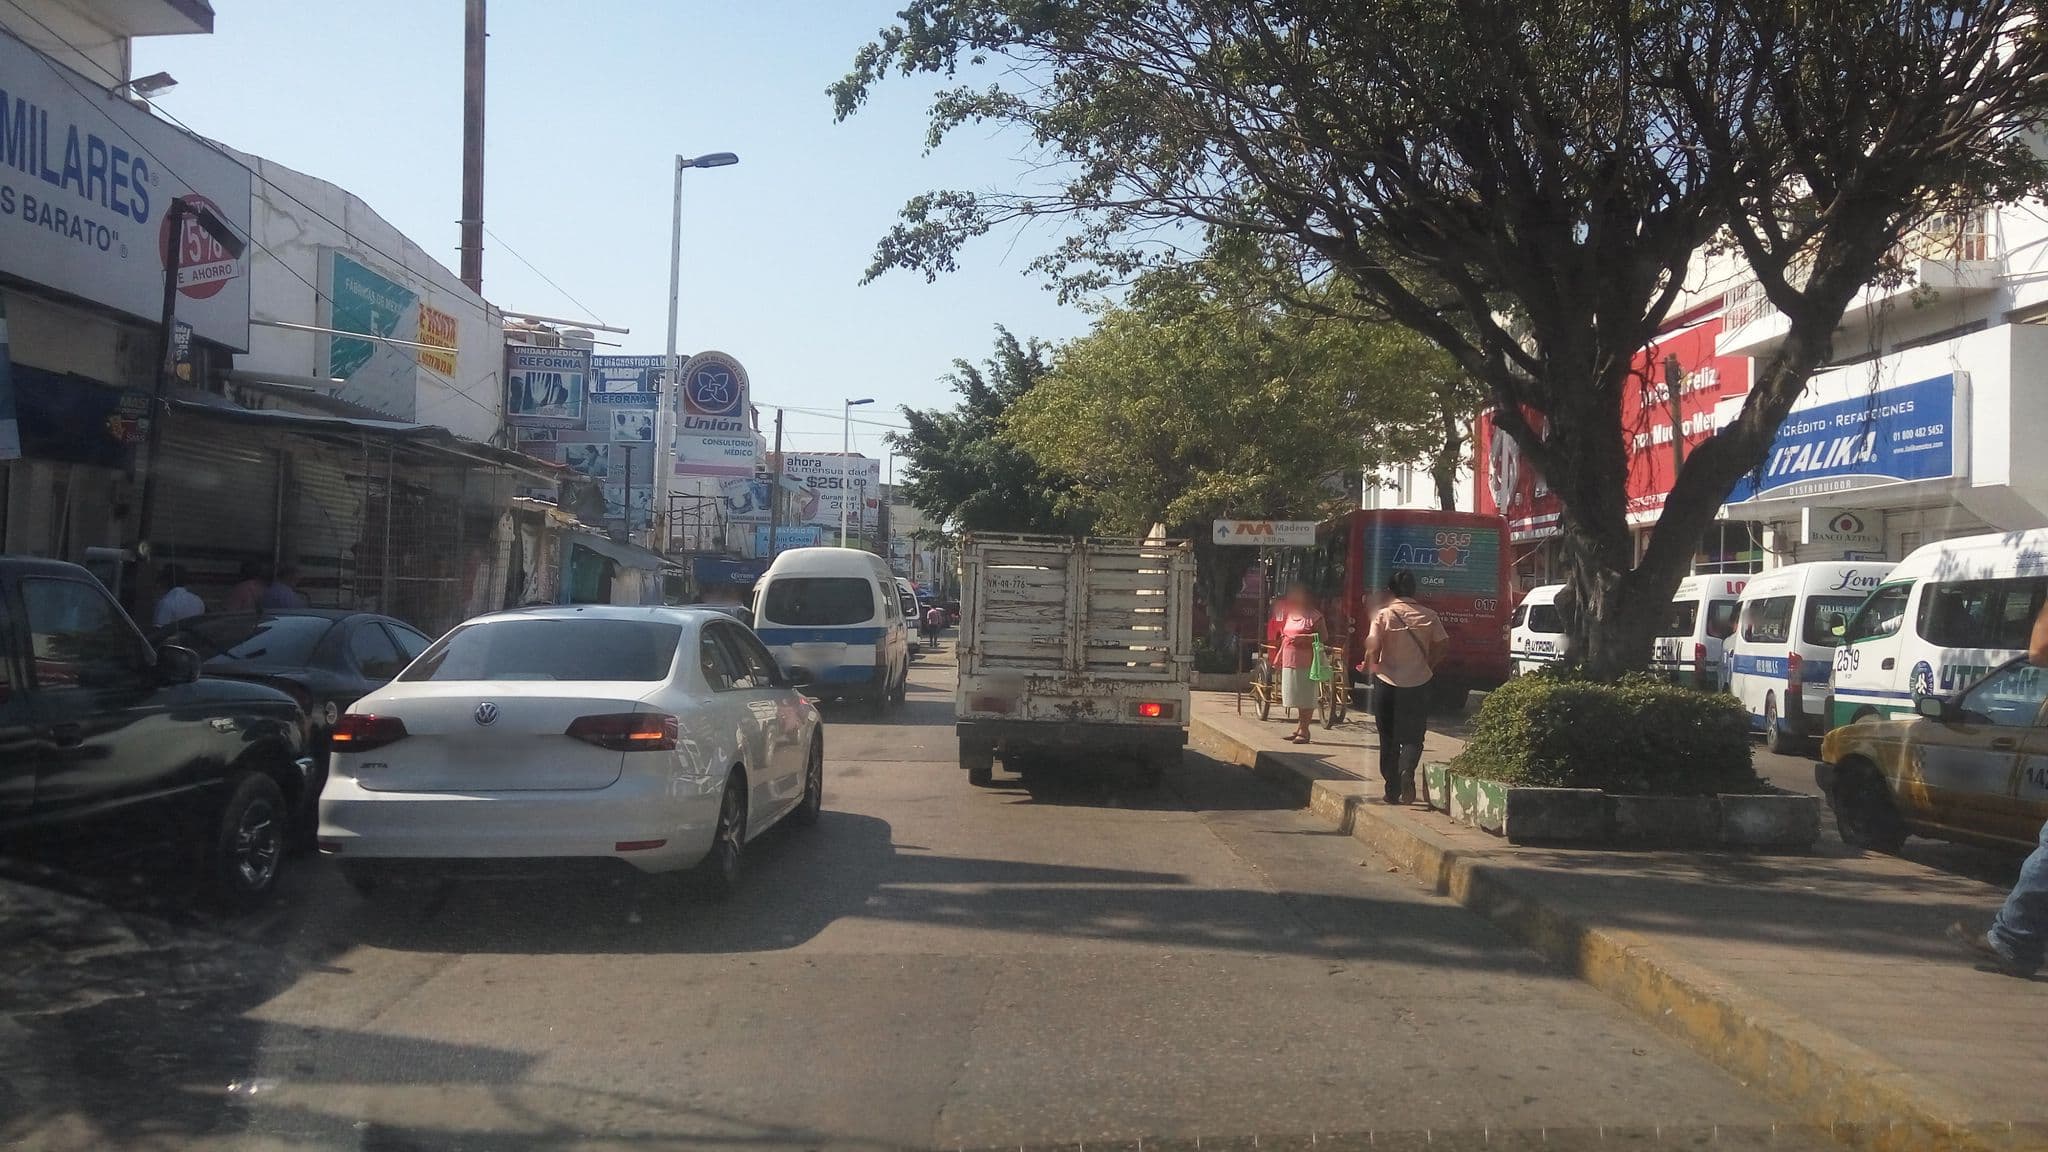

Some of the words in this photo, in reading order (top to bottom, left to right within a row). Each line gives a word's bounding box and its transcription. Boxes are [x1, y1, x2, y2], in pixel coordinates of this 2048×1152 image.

[192, 264, 233, 281] AHORRO
[514, 347, 548, 356] UNIDAD
[518, 356, 583, 369] REFORMA
[1687, 366, 1717, 393] Feliz
[594, 394, 648, 404] REFORMA
[702, 438, 754, 447] CONSULTORIO
[1893, 431, 1901, 442] 01
[1768, 431, 1877, 478] ITALIKA
[786, 457, 822, 468] ahora
[1435, 532, 1472, 547] 96.5
[1812, 531, 1842, 542] BANCO
[1844, 534, 1879, 544] AZTECA
[1474, 599, 1498, 612] 017
[1837, 649, 1860, 672] 2519
